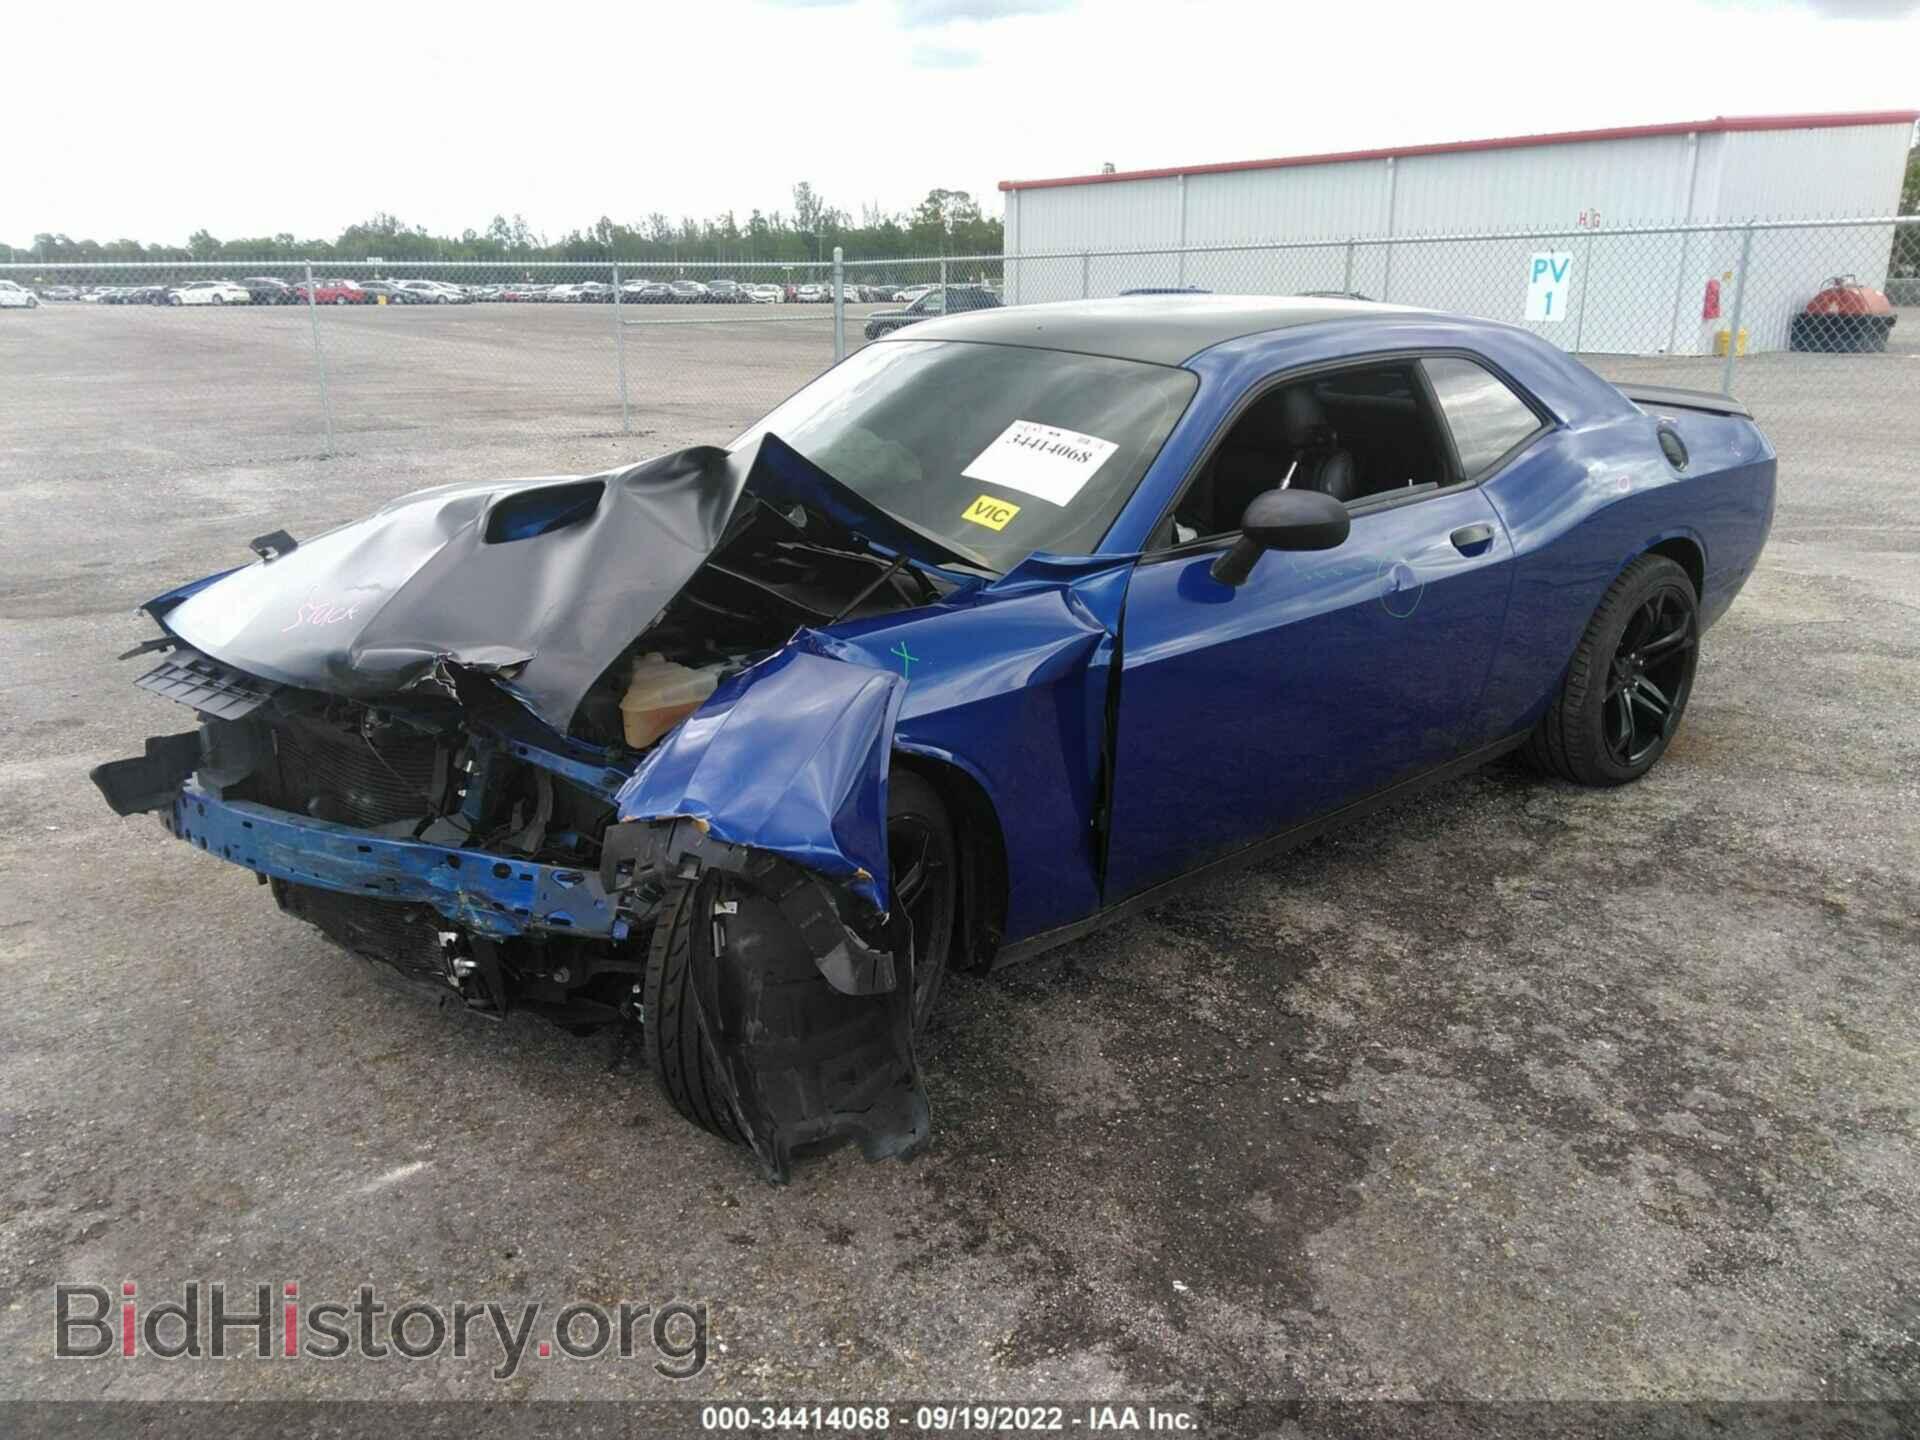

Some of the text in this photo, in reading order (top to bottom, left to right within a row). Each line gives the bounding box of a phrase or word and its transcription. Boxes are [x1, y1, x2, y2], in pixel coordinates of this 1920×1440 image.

[1532, 258, 1570, 283] PV
[1544, 291, 1553, 315] 1
[1006, 434, 1093, 464] 34414068
[973, 501, 1010, 523] VIC
